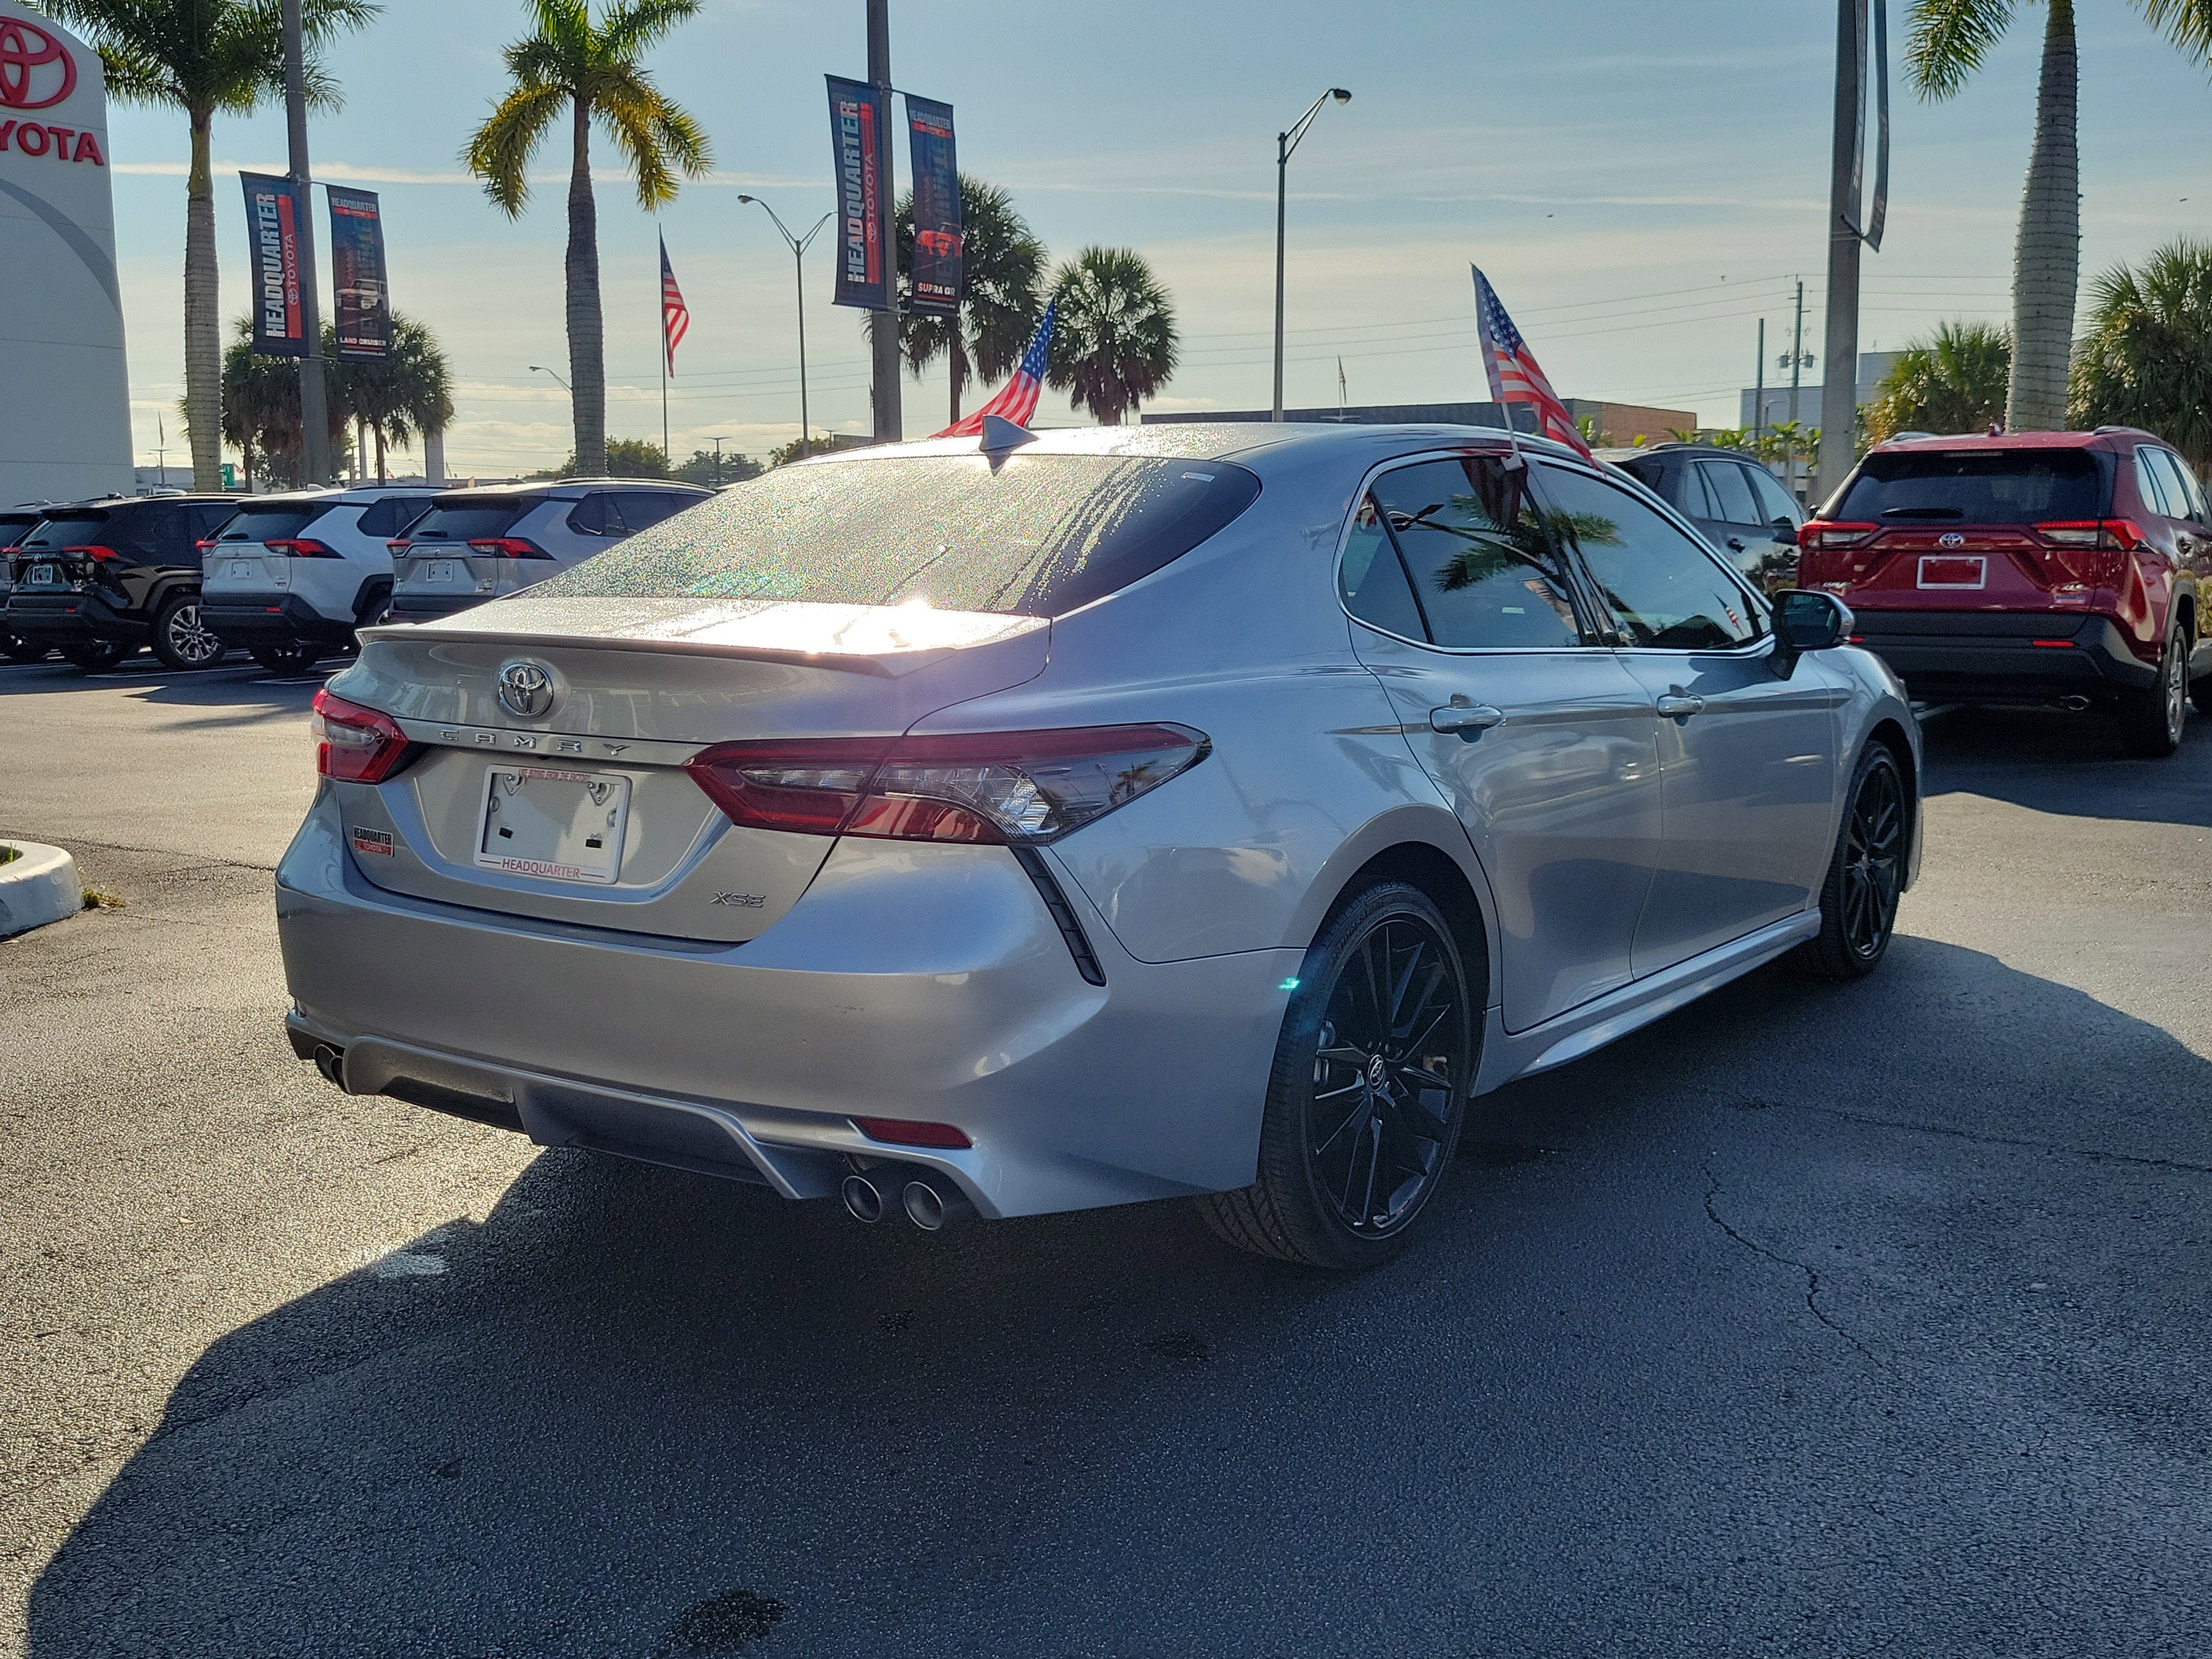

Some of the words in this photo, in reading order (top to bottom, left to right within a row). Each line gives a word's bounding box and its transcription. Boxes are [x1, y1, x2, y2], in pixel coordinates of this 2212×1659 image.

[840, 101, 866, 283] HEADQUARTER
[865, 153, 876, 218] TOYOTA
[256, 193, 286, 338] HEADQUARTER
[285, 234, 297, 286] TOYOTA
[918, 282, 943, 295] SUPRA
[944, 286, 956, 296] GR
[340, 336, 358, 345] LAND
[358, 338, 387, 346] CRUISER
[441, 729, 631, 756] CAMRY
[354, 827, 392, 845] HEADQUARTER
[502, 858, 580, 879] HEADQUARTER
[710, 890, 766, 908] XSE
